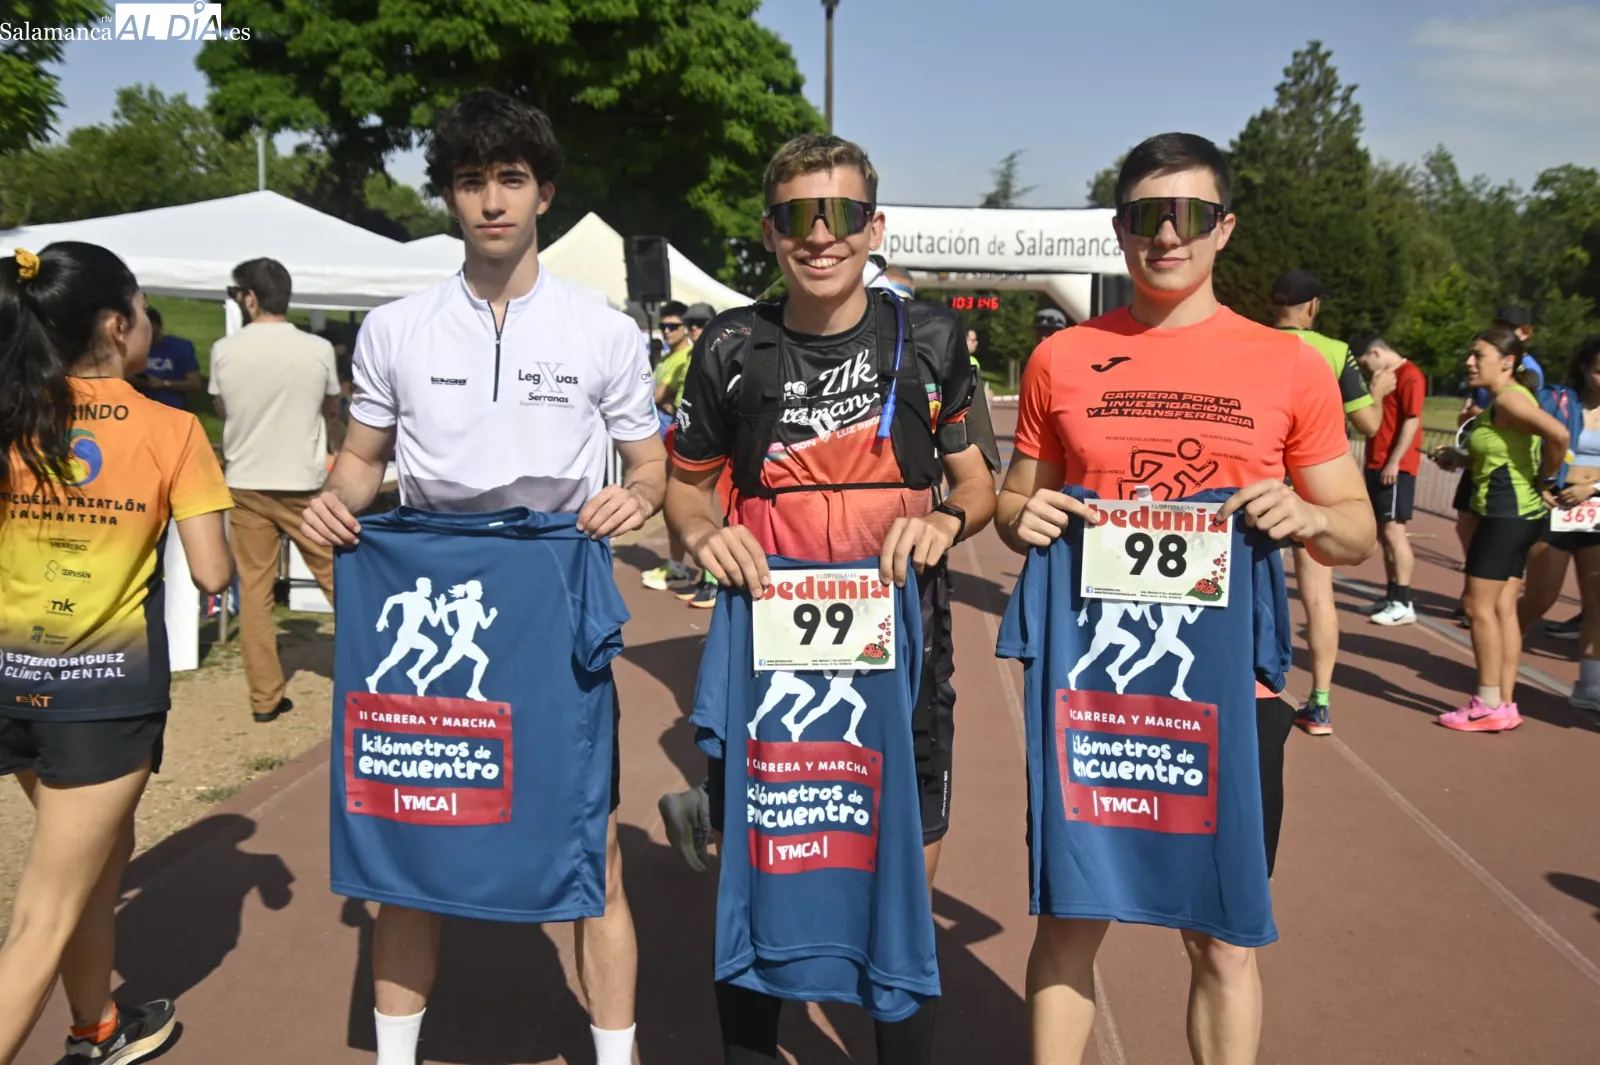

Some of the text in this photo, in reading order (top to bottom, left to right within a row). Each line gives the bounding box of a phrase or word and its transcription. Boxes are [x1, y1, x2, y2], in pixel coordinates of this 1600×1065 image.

[883, 229, 1123, 261] iputación de Salamanca
[527, 391, 570, 404] Serranas
[1104, 391, 1240, 408] CARRERA POR LA
[1108, 399, 1232, 415] INVESTIGACIÓN
[1087, 408, 1254, 428] Y LA TRANSFERENCIA
[66, 496, 147, 513] TRIATLÓN
[1124, 532, 1188, 578] 98
[793, 602, 854, 646] 99
[60, 667, 126, 681] DENTAL
[371, 712, 426, 725] CARRERA
[430, 716, 438, 726] Y
[442, 716, 497, 729] MARCHA
[1131, 715, 1140, 725] Y
[1144, 715, 1202, 731] MARCHA
[361, 733, 492, 760] kilómetros de
[1176, 748, 1195, 764] de
[358, 755, 500, 780] encuentro
[752, 758, 801, 773] CARRERA
[805, 761, 814, 772] Y
[818, 760, 869, 776] MARCHA
[400, 794, 449, 812] YMCA
[847, 790, 864, 805] de
[1100, 796, 1151, 815] YMCA
[776, 840, 821, 861] YMCA
